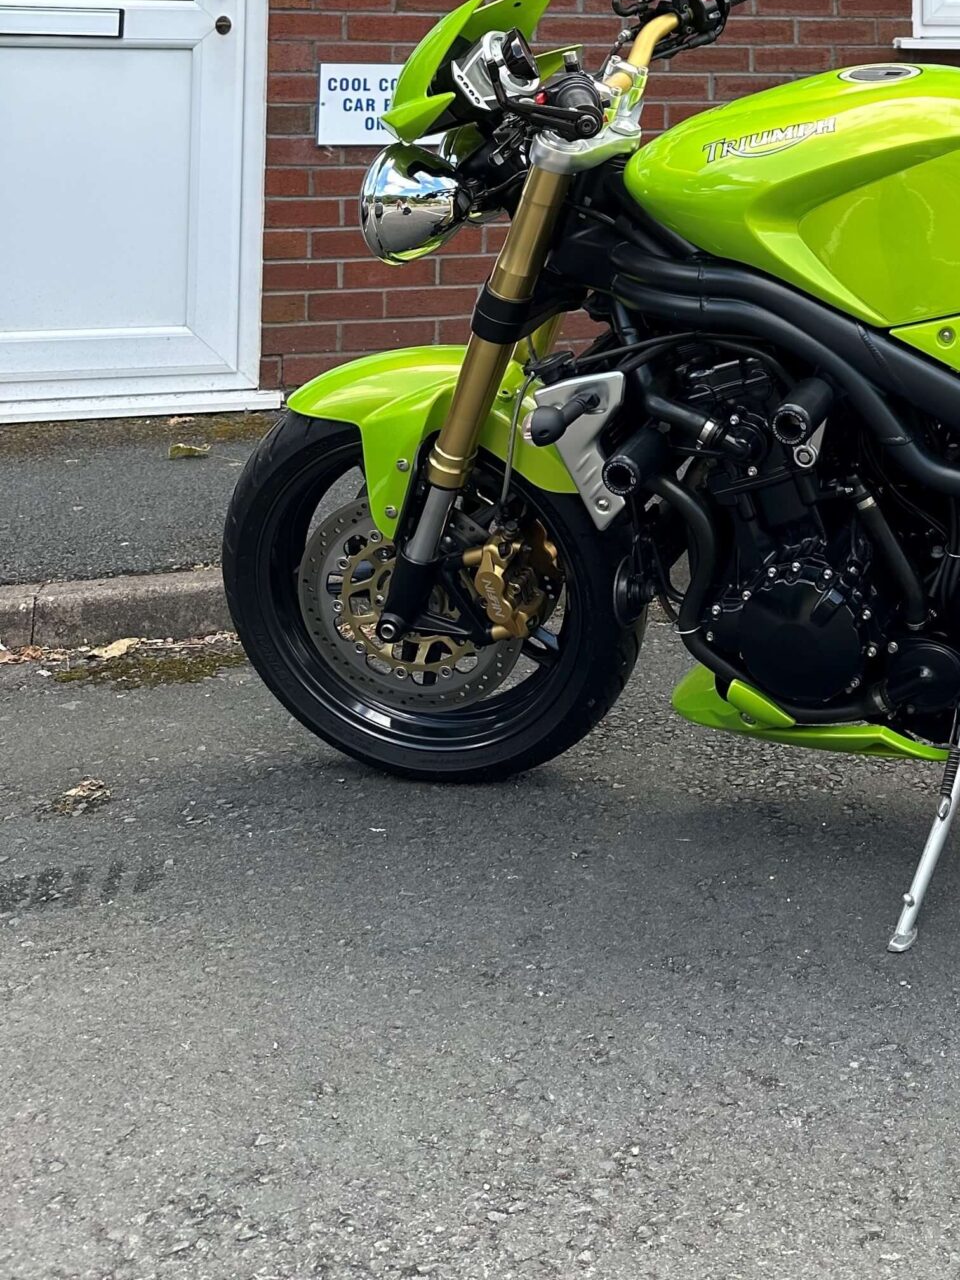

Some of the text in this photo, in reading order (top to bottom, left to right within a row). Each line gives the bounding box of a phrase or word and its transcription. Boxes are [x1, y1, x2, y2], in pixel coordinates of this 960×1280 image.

[328, 77, 371, 92] COOL
[343, 98, 375, 111] CAR
[702, 117, 836, 164] TRIUMPH
